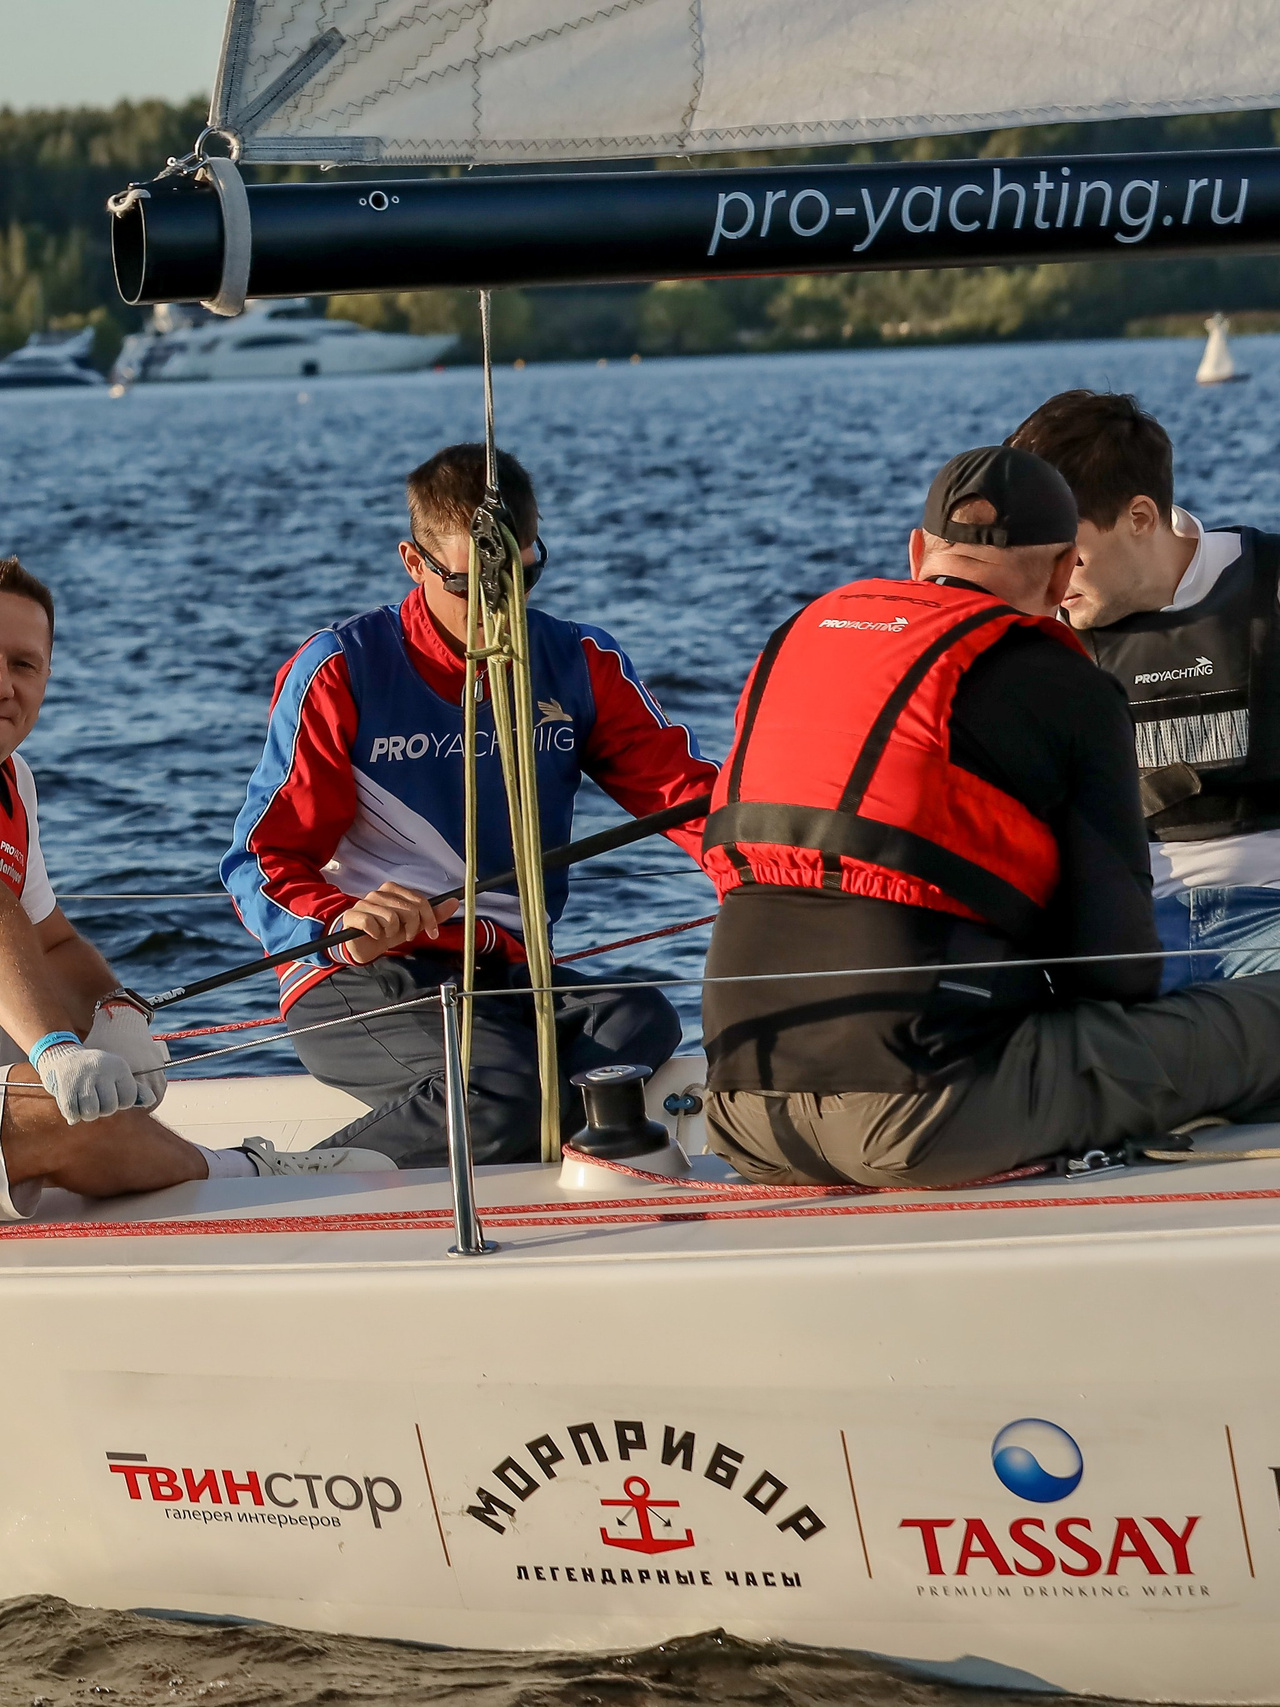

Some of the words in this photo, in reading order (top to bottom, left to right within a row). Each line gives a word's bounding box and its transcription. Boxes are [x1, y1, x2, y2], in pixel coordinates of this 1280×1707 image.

[706, 166, 1250, 257] pro-yachting.ru
[818, 618, 906, 633] PROYACHTING
[1134, 664, 1214, 685] PROYACHTING
[466, 1420, 827, 1542] МОРПРИБОР
[164, 1506, 234, 1527] галерея
[237, 1510, 342, 1532] интерьеров
[899, 1516, 1202, 1577] TASSAY
[516, 1565, 713, 1586] ЛЕГЕНДАРНЫЕ
[725, 1570, 802, 1588] ЧАСЫ
[915, 1585, 1012, 1598] PREMIUM
[1023, 1585, 1131, 1598] DRINKING
[1141, 1584, 1212, 1598] WATER
